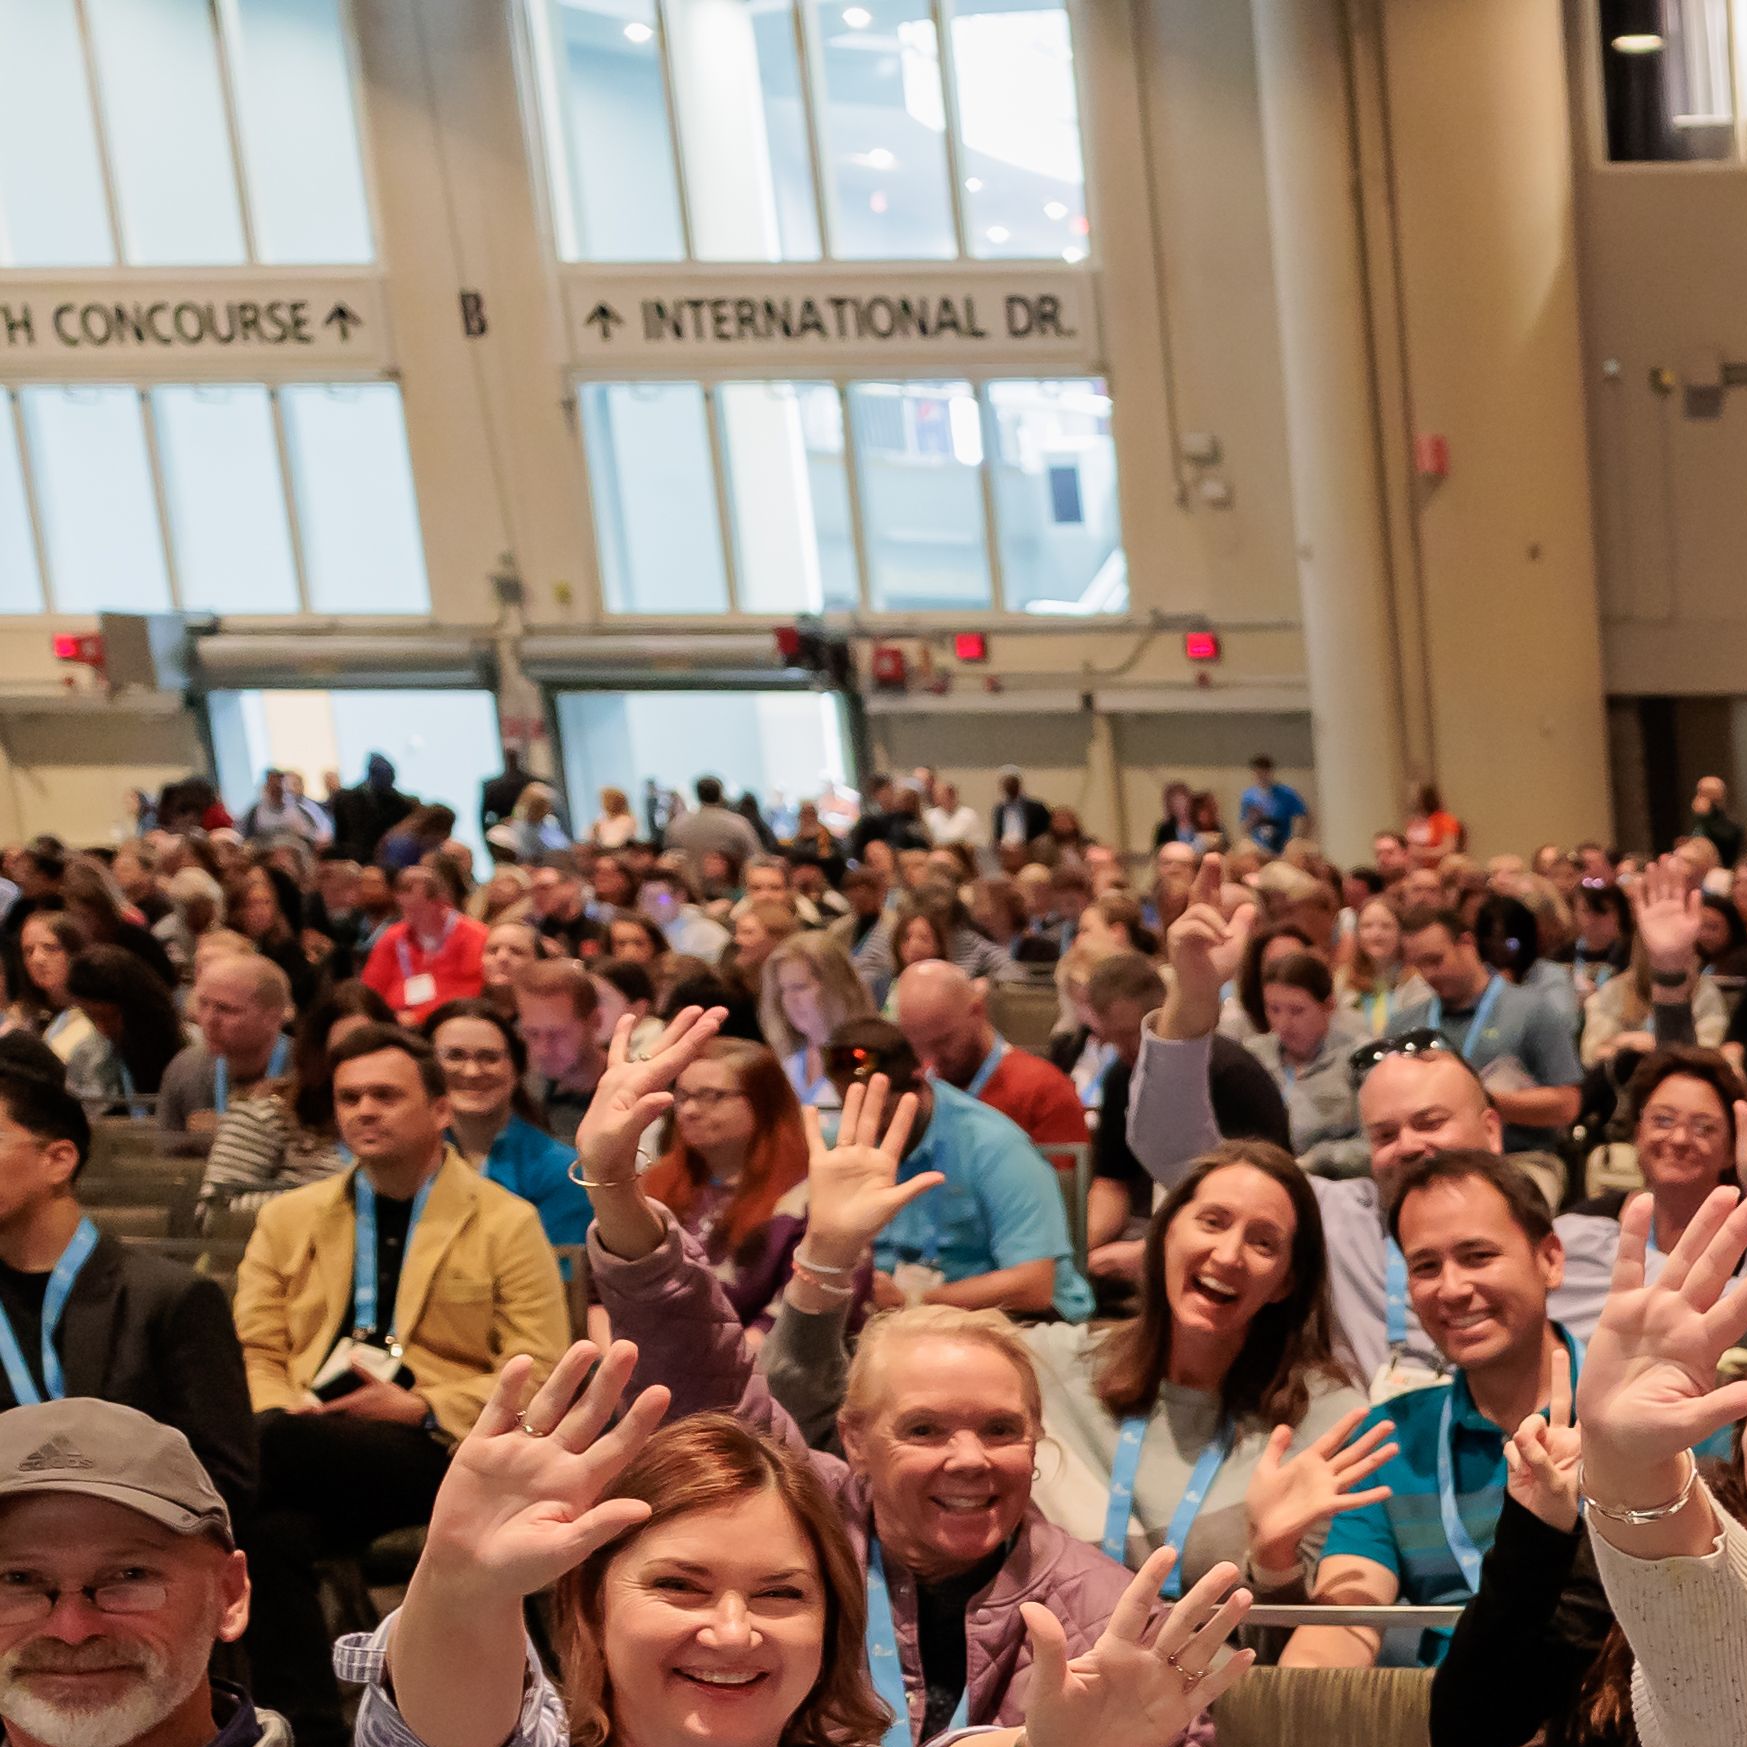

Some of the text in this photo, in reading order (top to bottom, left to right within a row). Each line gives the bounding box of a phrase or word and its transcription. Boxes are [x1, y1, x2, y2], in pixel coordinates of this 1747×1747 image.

[0, 300, 313, 347] H CONCOURSE
[461, 290, 489, 338] B
[643, 294, 1077, 343] INTERNATIONAL DR.
